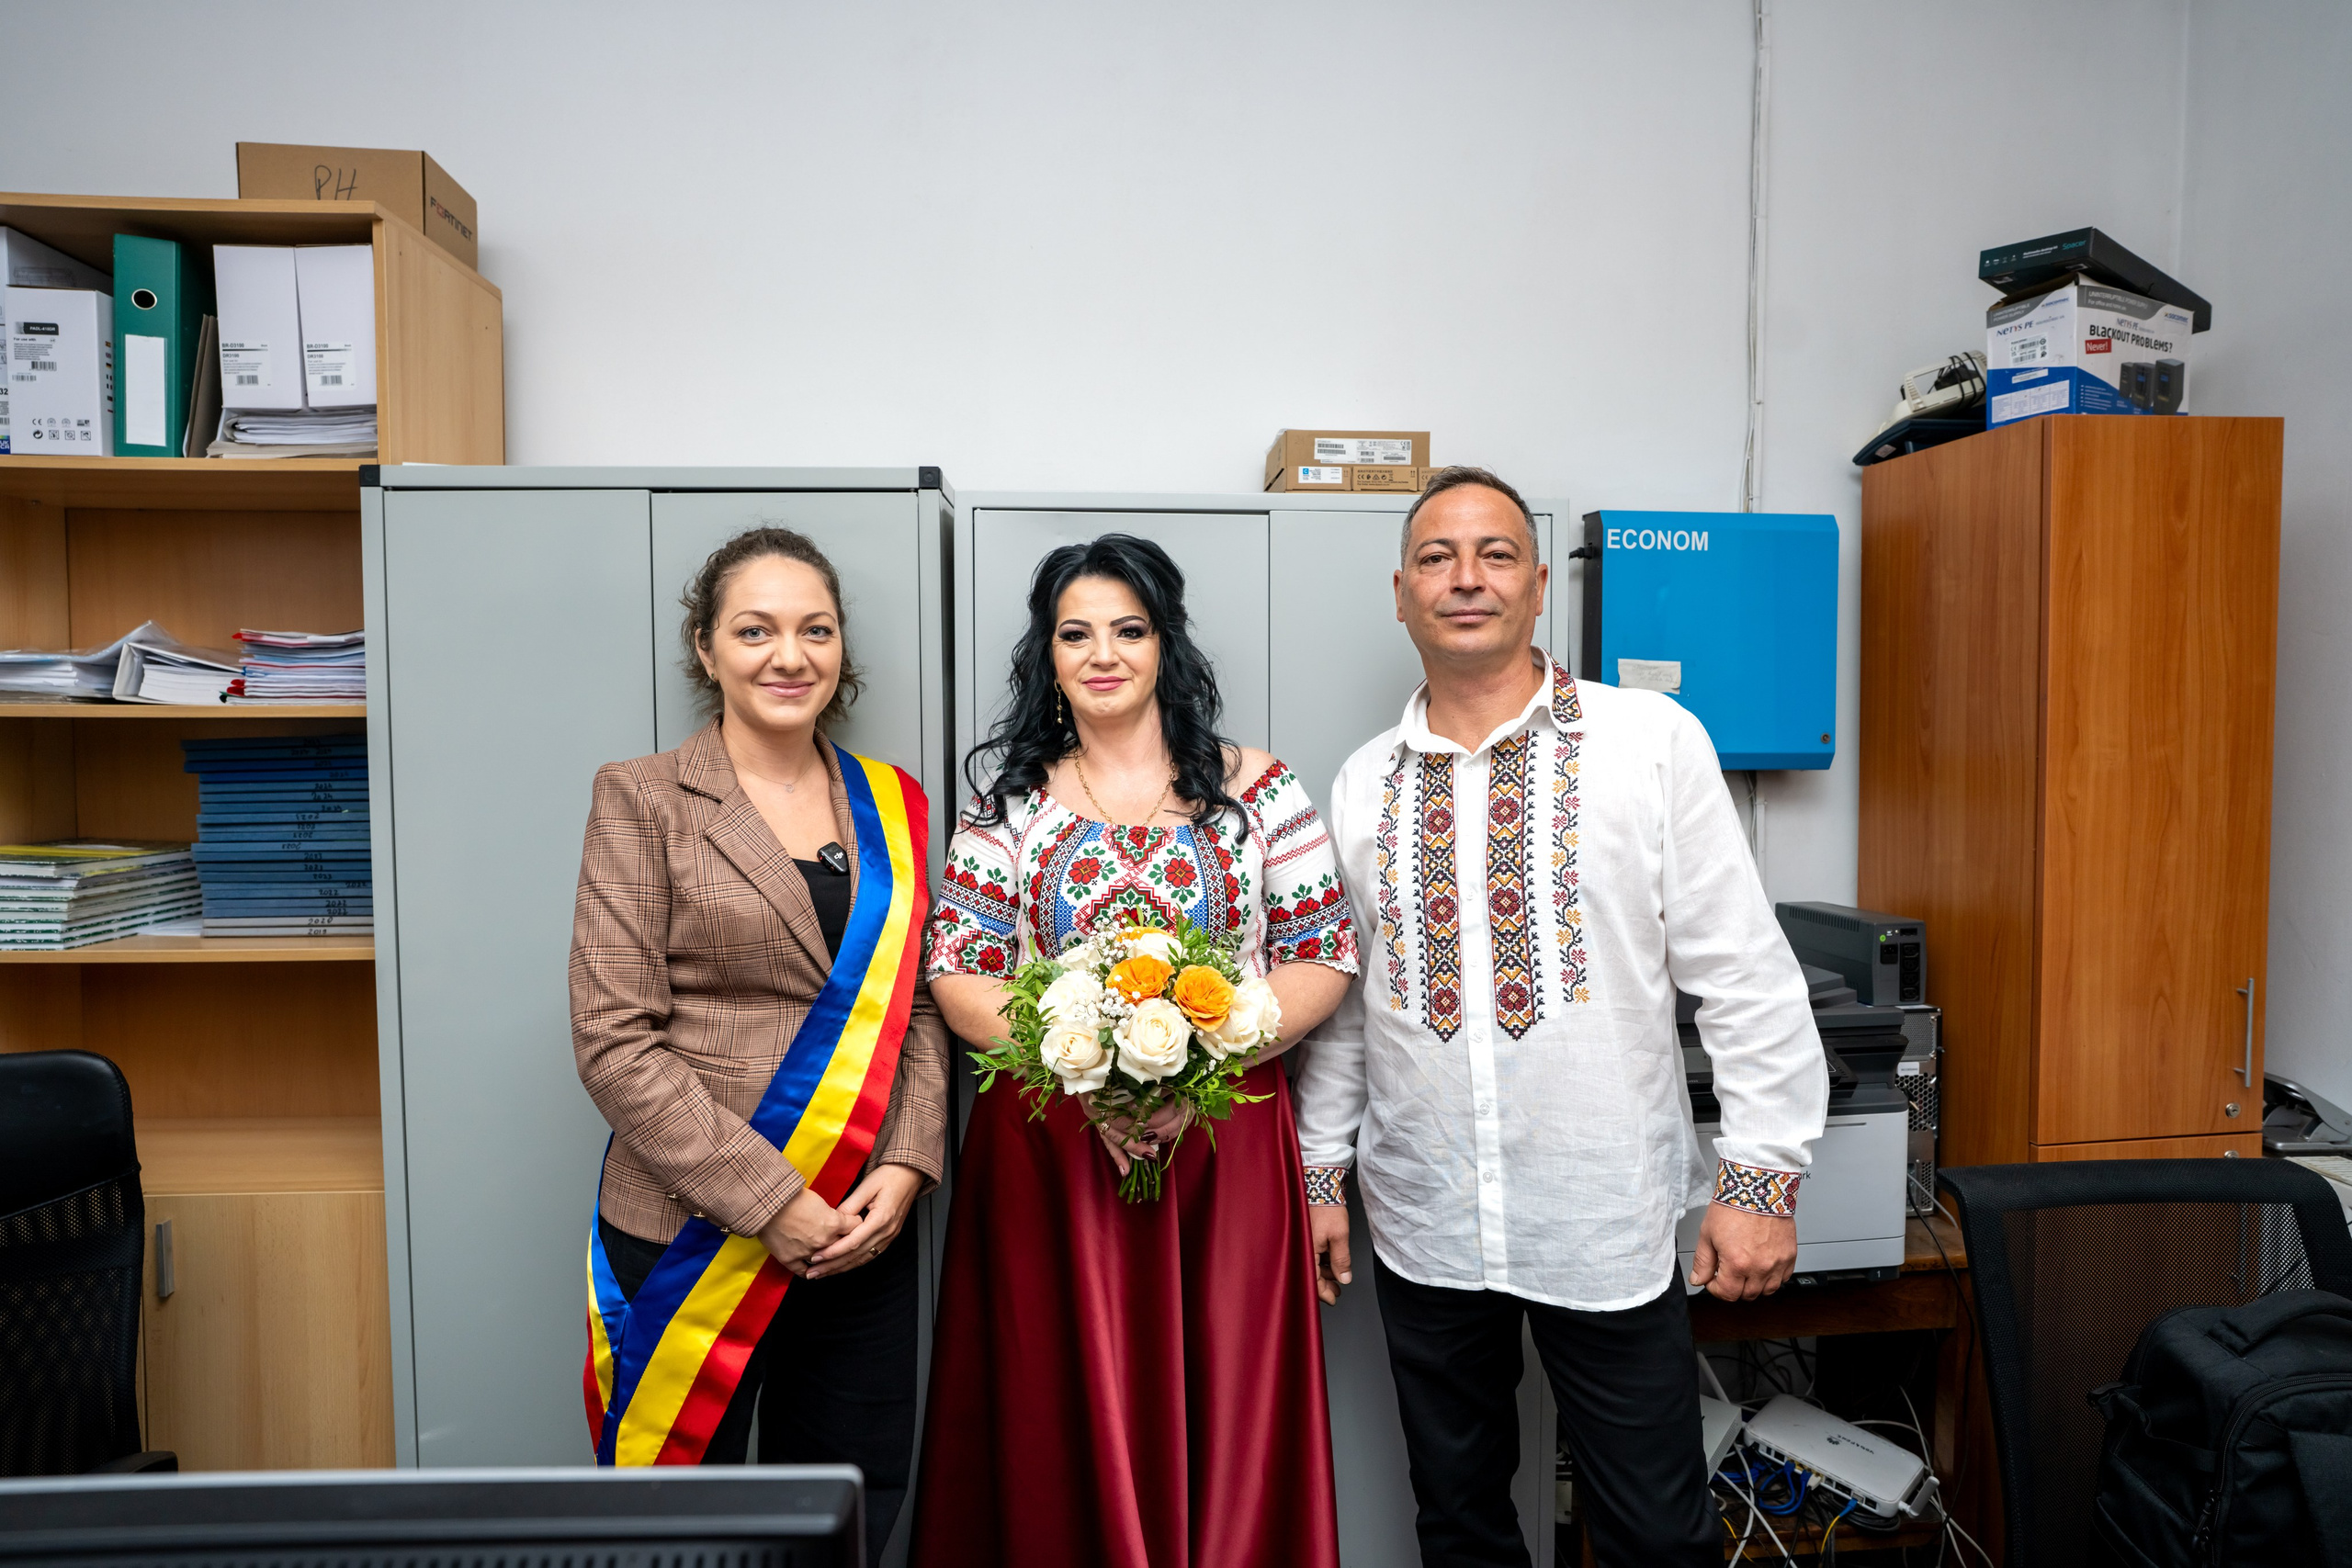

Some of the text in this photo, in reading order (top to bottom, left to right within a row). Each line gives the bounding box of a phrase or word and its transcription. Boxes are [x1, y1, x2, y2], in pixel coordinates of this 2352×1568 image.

[430, 196, 472, 242] FORTINET
[2062, 240, 2086, 251] Spacer
[2086, 342, 2109, 352] Never!
[1607, 528, 1709, 551] ECONOM
[308, 916, 333, 926] 2020
